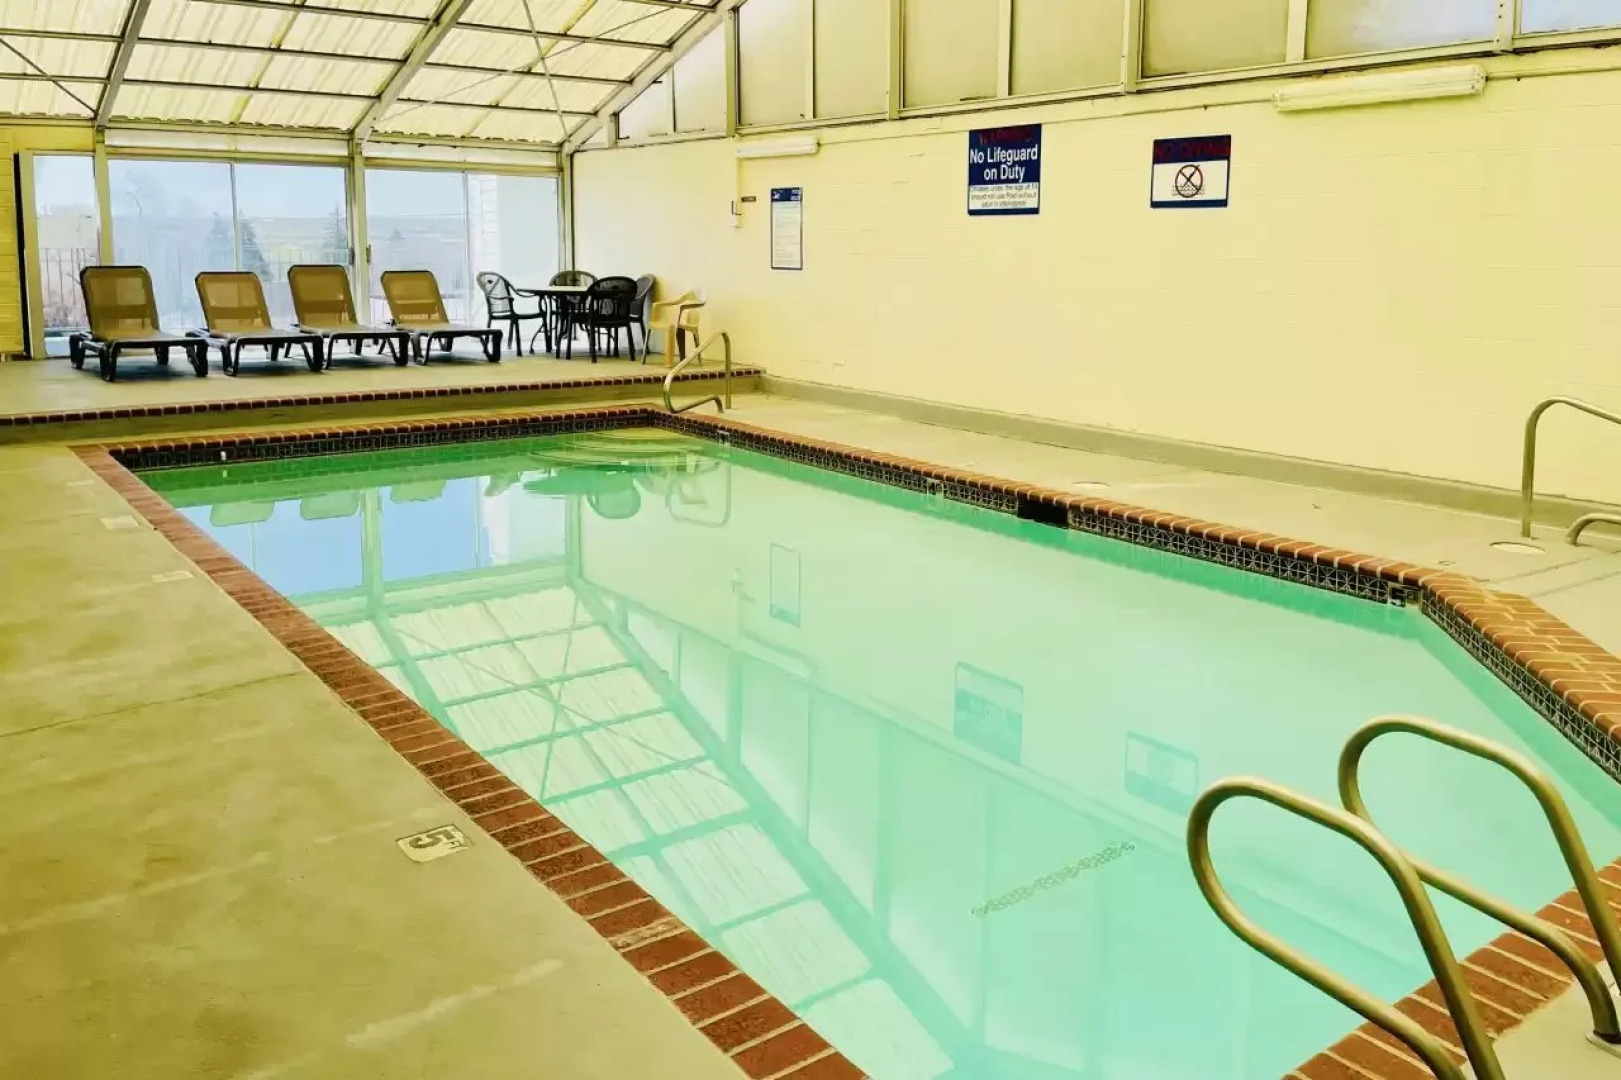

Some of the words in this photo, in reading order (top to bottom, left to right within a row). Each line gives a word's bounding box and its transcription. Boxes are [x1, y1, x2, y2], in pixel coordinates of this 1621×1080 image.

[970, 148, 984, 164] No
[987, 144, 1038, 165] Lifeguard
[984, 168, 997, 180] on
[1001, 164, 1025, 182] Duty
